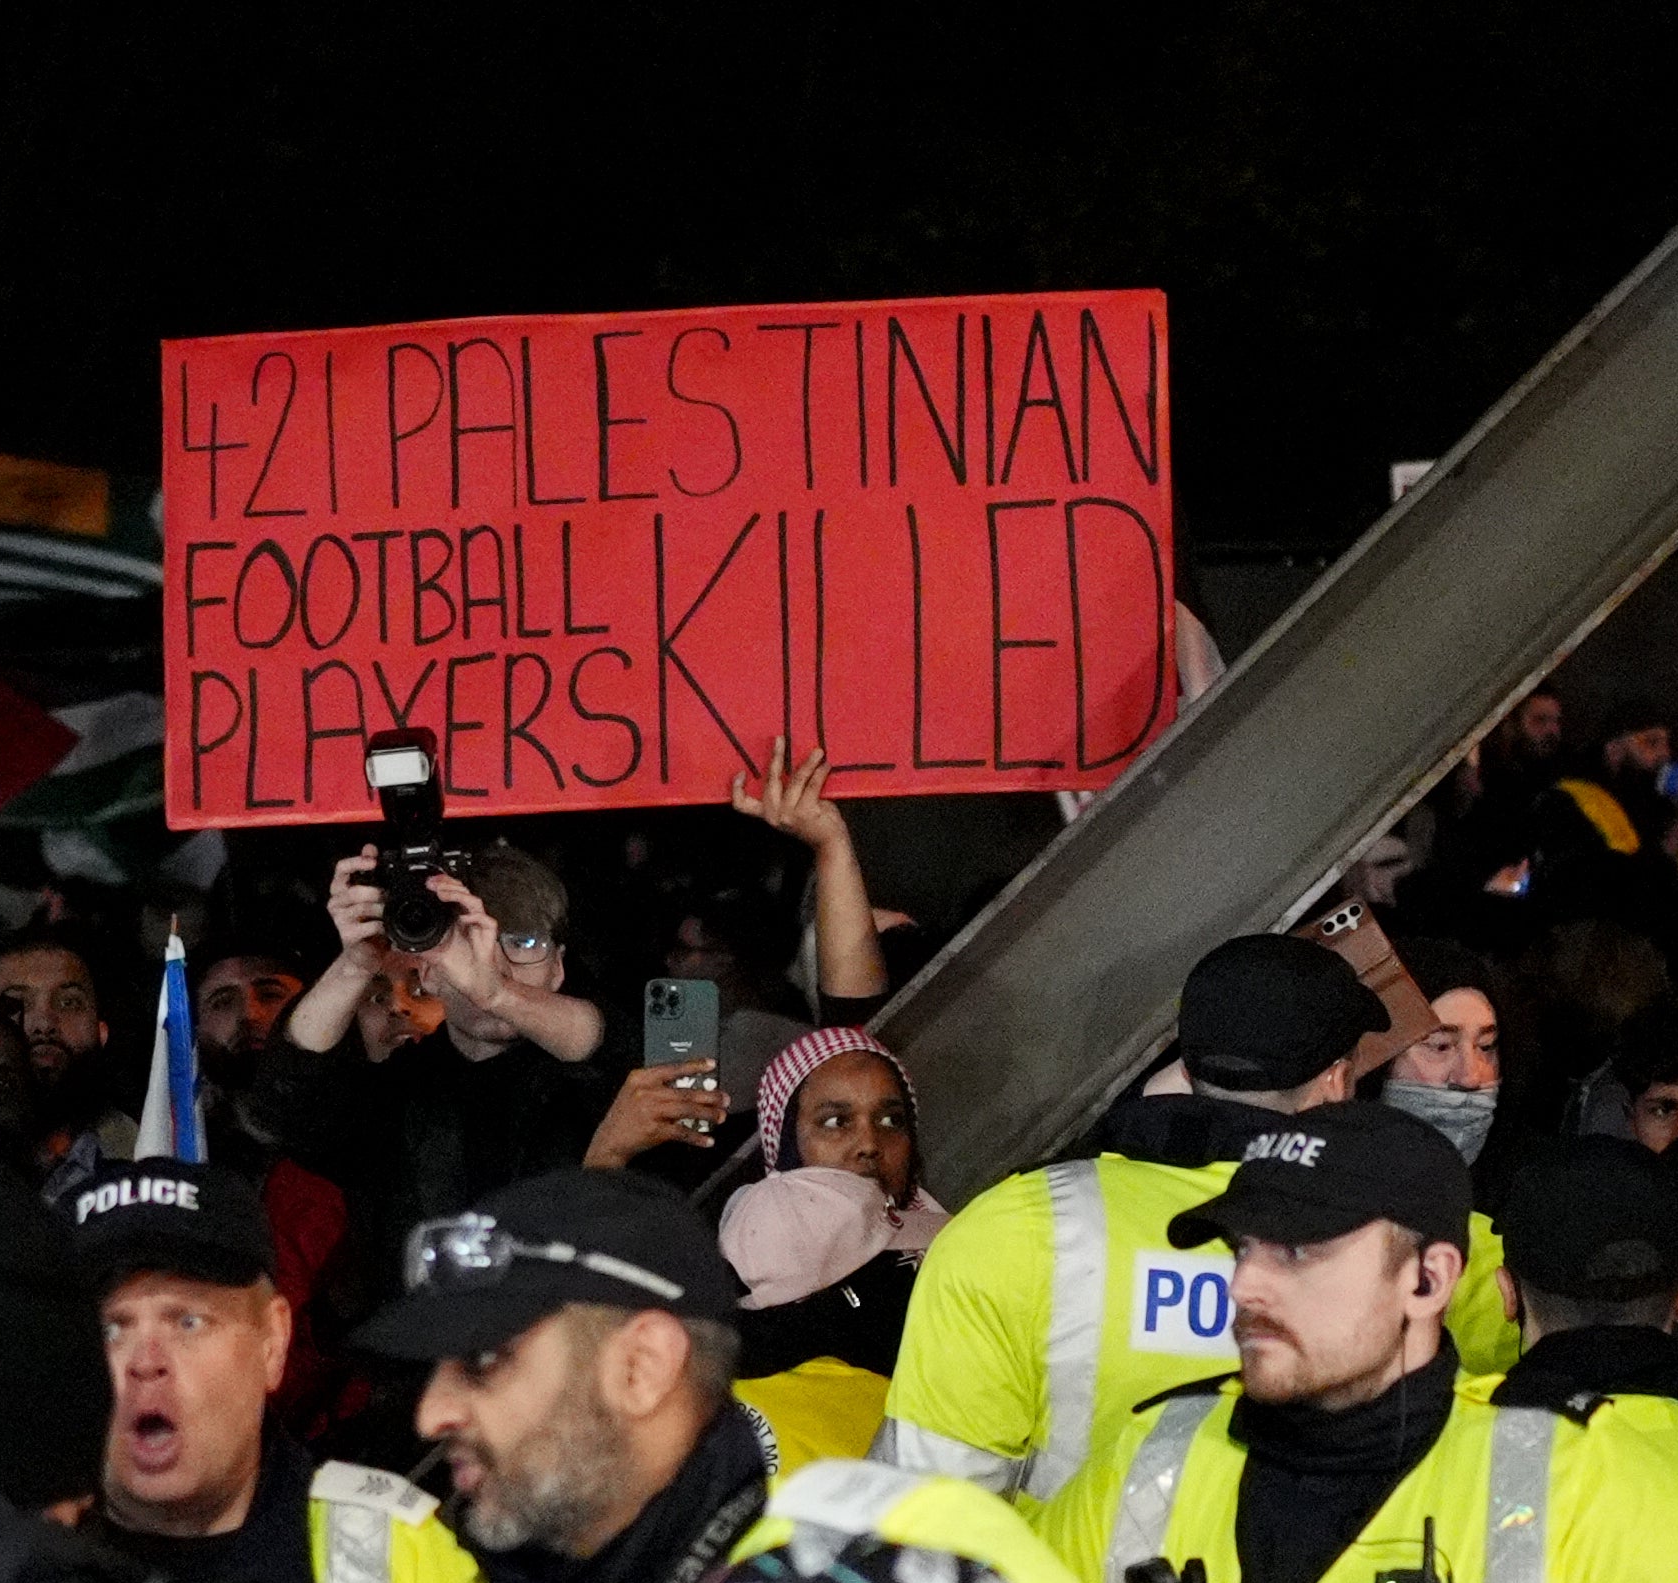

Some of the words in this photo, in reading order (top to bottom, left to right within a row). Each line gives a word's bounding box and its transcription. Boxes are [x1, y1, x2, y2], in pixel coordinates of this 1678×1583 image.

[181, 350, 339, 520] 421
[387, 308, 1161, 511] PALESTINIAN
[185, 520, 611, 658] FOOTBALL
[653, 496, 1167, 786] KILLED
[75, 1176, 200, 1224] POLICE
